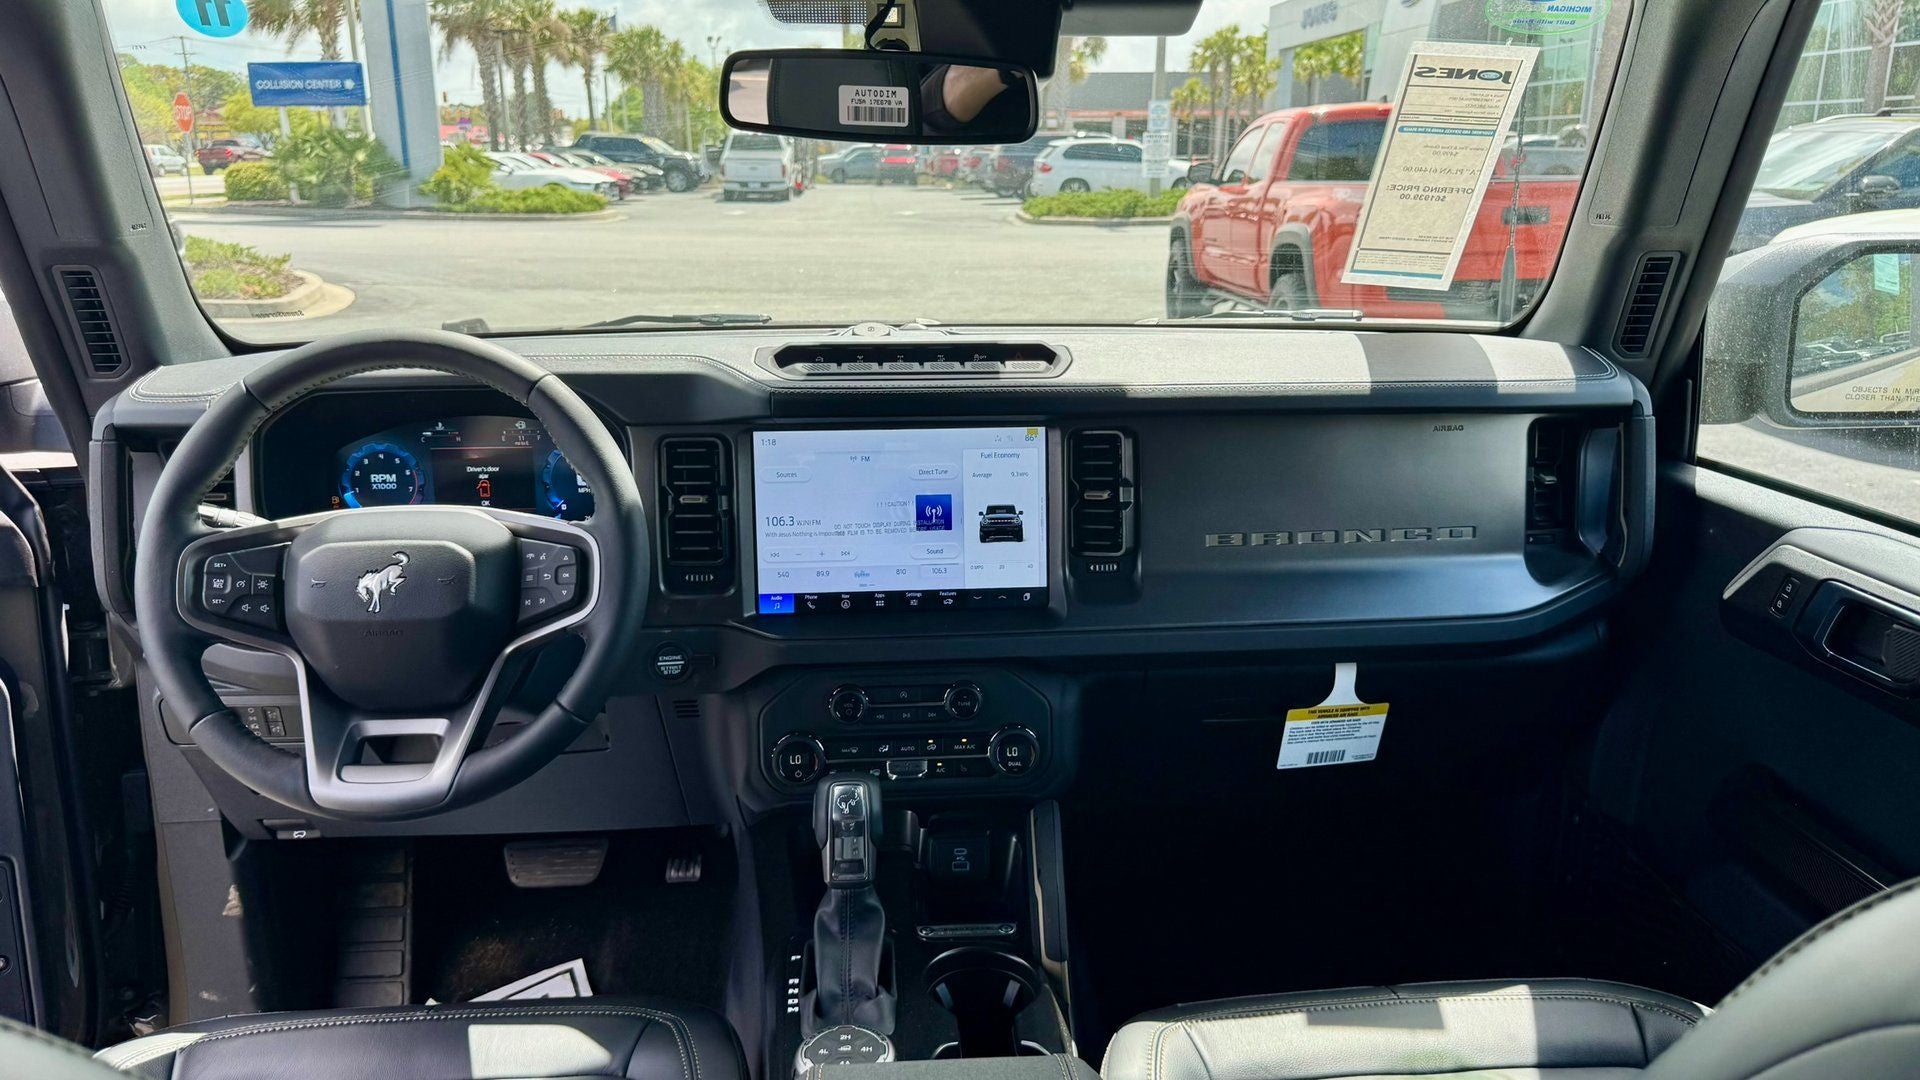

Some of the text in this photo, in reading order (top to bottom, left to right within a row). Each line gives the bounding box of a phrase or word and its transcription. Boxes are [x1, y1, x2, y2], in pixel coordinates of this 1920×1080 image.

[255, 79, 342, 90] COLLISION CENTER
[854, 89, 897, 98] AUTODIM
[175, 105, 192, 119] STOP
[1851, 385, 1888, 394] OBJECTS
[1845, 393, 1876, 401] CLOSER
[1432, 424, 1465, 433] AIRBAG
[761, 438, 777, 447] 1:18
[993, 452, 1020, 460] Economy
[370, 473, 397, 483] RPM
[776, 471, 798, 480] Sources
[765, 515, 795, 527] 106.3
[1205, 525, 1477, 548] BRONCO
[860, 1045, 873, 1053] 4H
